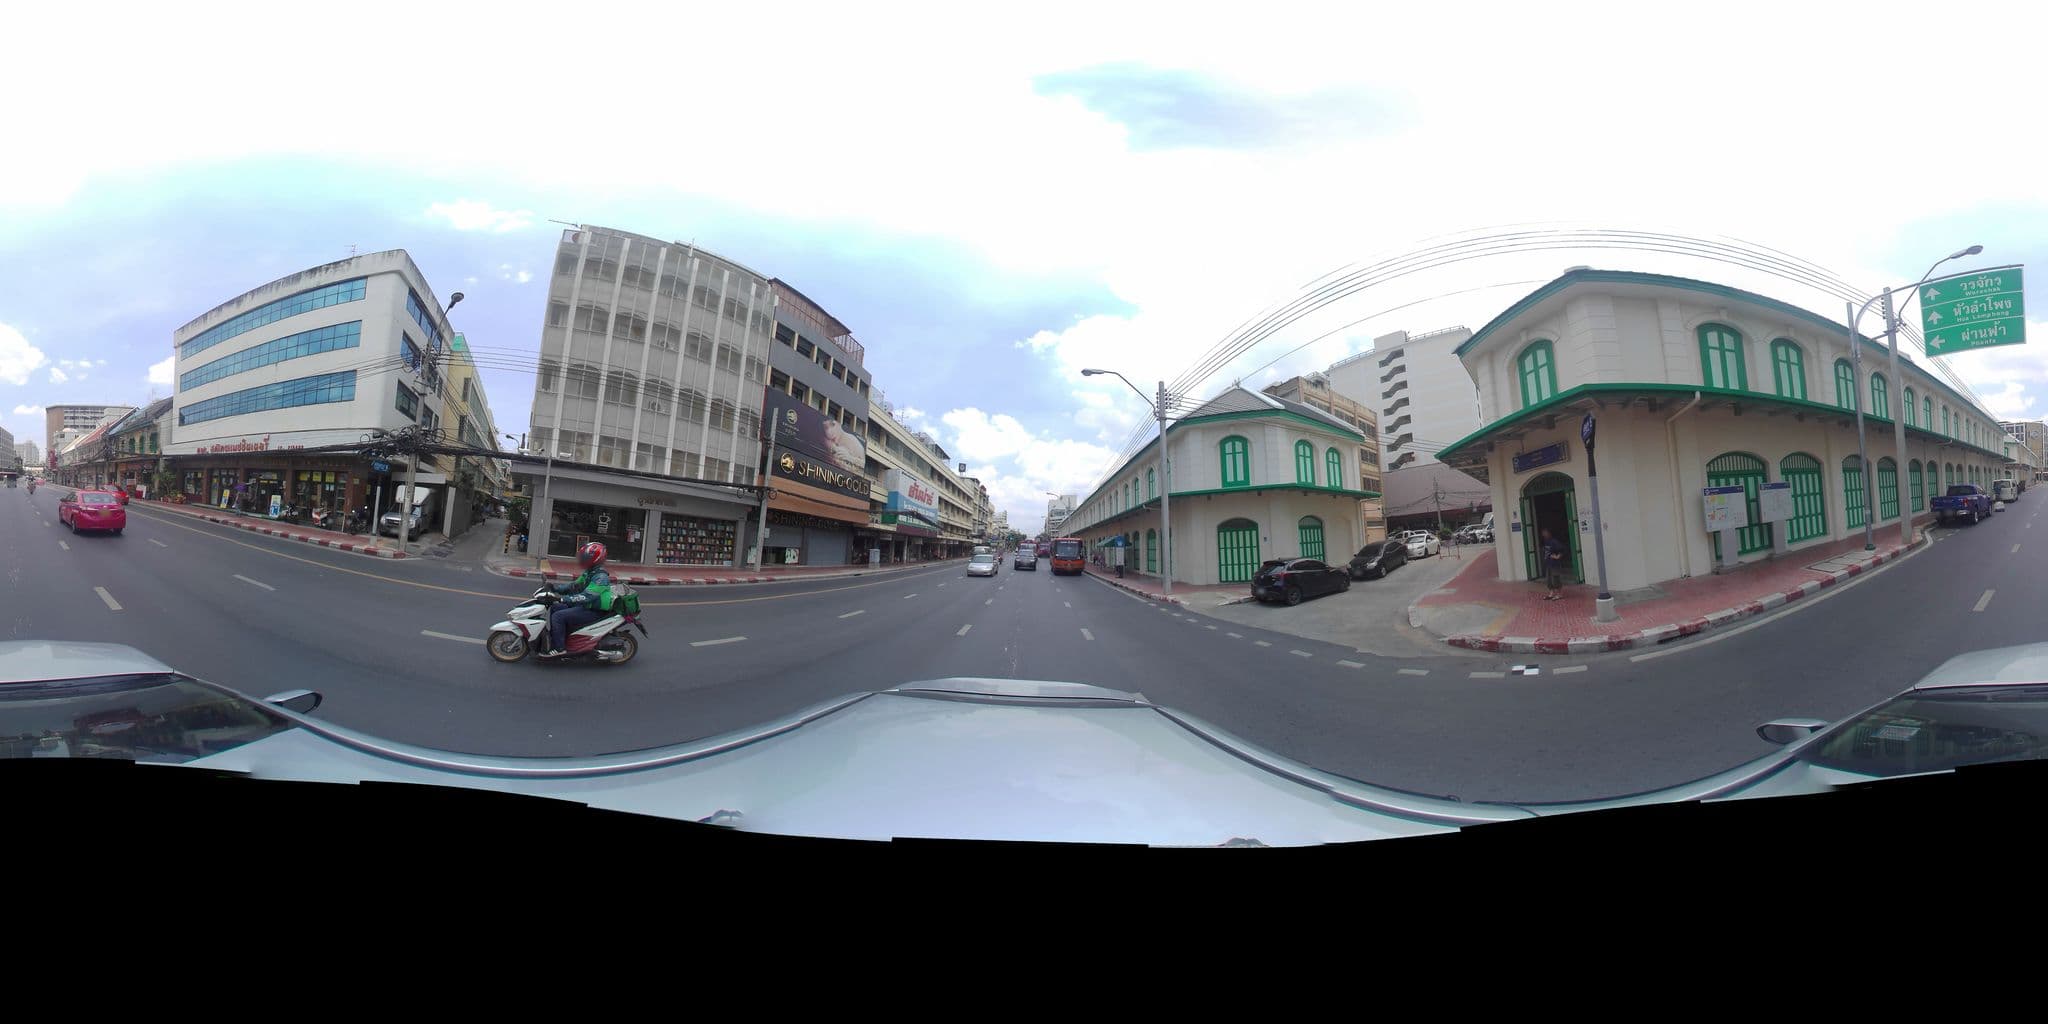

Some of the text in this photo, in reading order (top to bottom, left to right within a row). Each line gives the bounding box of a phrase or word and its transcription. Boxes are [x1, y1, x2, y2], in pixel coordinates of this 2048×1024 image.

[1953, 296, 2012, 316] หัวลำโพง
[1961, 320, 2006, 341] ผ่านฟ้า
[799, 461, 870, 495] SHINING GOLD
